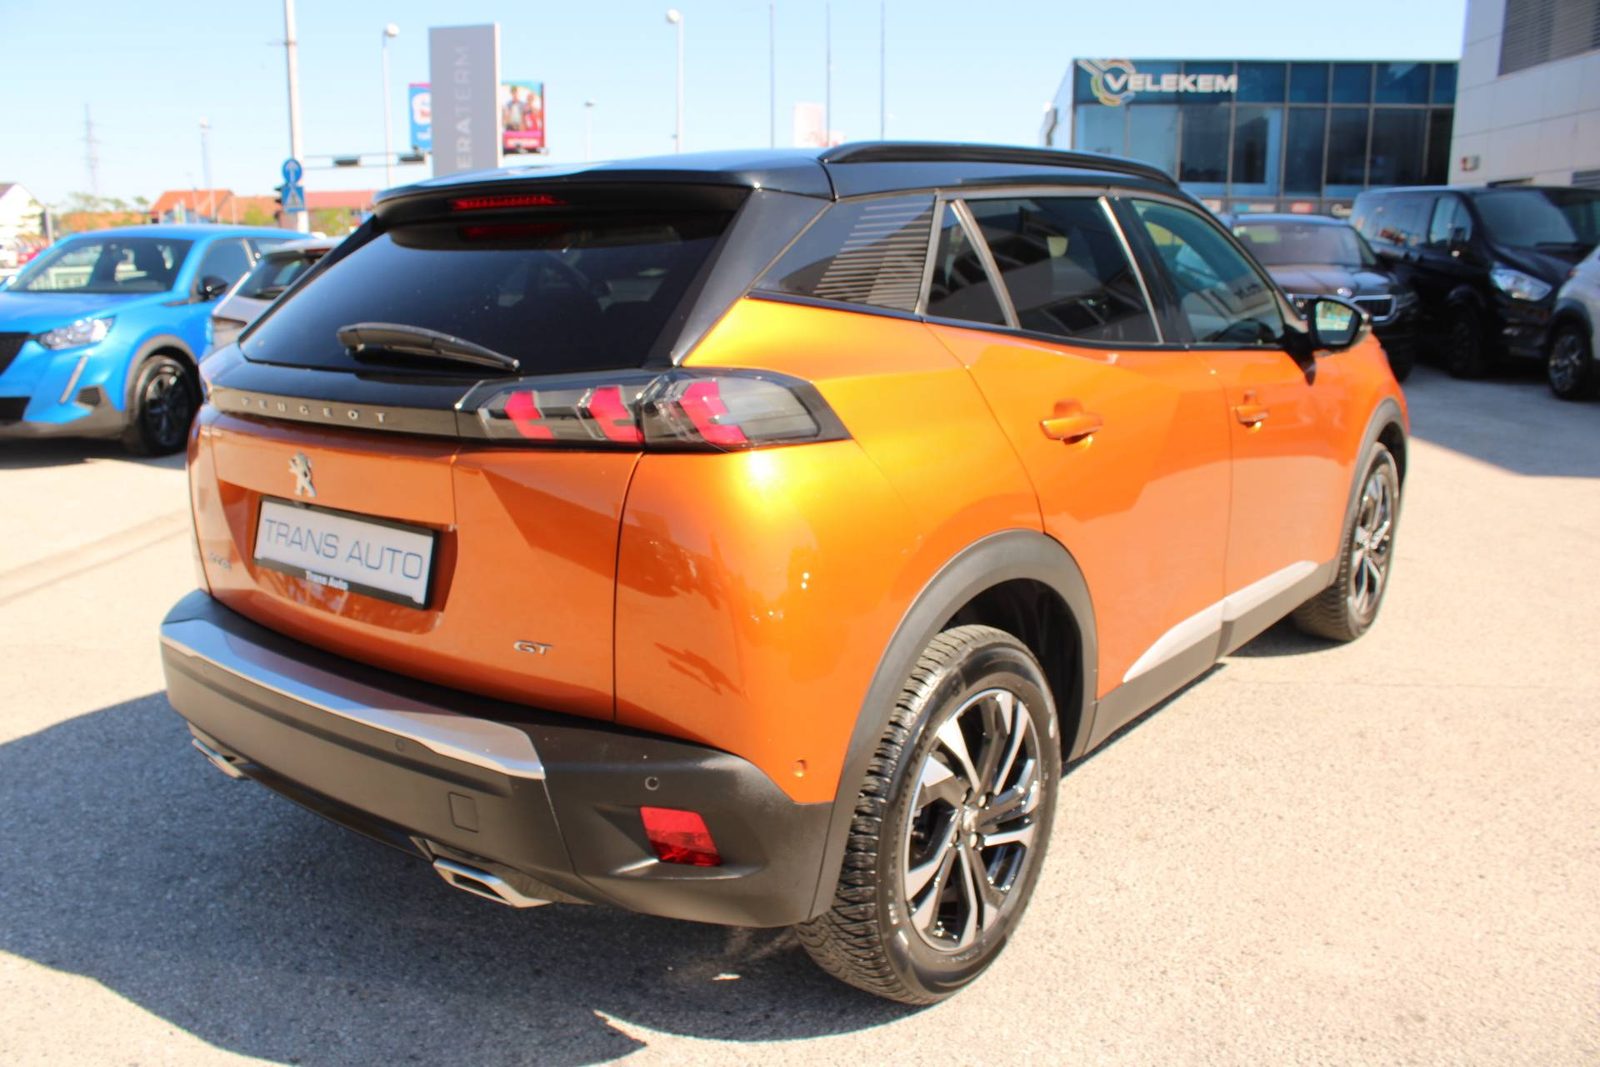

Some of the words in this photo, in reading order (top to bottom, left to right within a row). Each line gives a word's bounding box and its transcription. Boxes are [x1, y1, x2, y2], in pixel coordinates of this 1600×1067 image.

[1103, 73, 1238, 93] VELEKEM
[241, 397, 387, 423] PEUGEOT
[264, 518, 339, 561] TRANS
[346, 540, 424, 580] AUTO
[513, 639, 553, 655] GT
